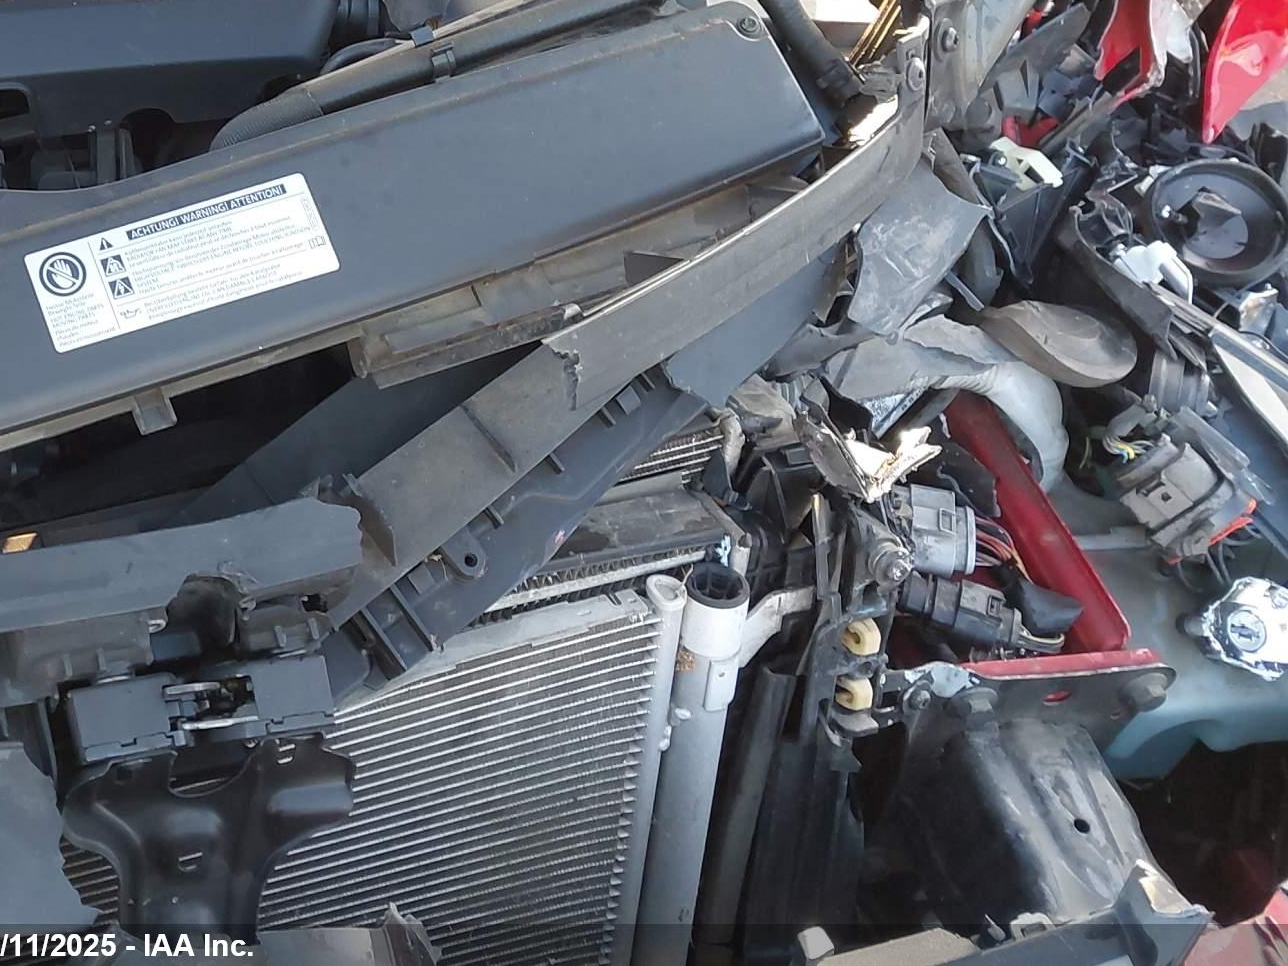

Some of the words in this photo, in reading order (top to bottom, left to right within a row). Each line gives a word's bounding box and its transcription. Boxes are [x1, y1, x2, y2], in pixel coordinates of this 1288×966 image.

[132, 218, 178, 237] ACHTUNG!
[180, 202, 228, 222] WARNING!
[231, 186, 282, 207] ATTENTION!
